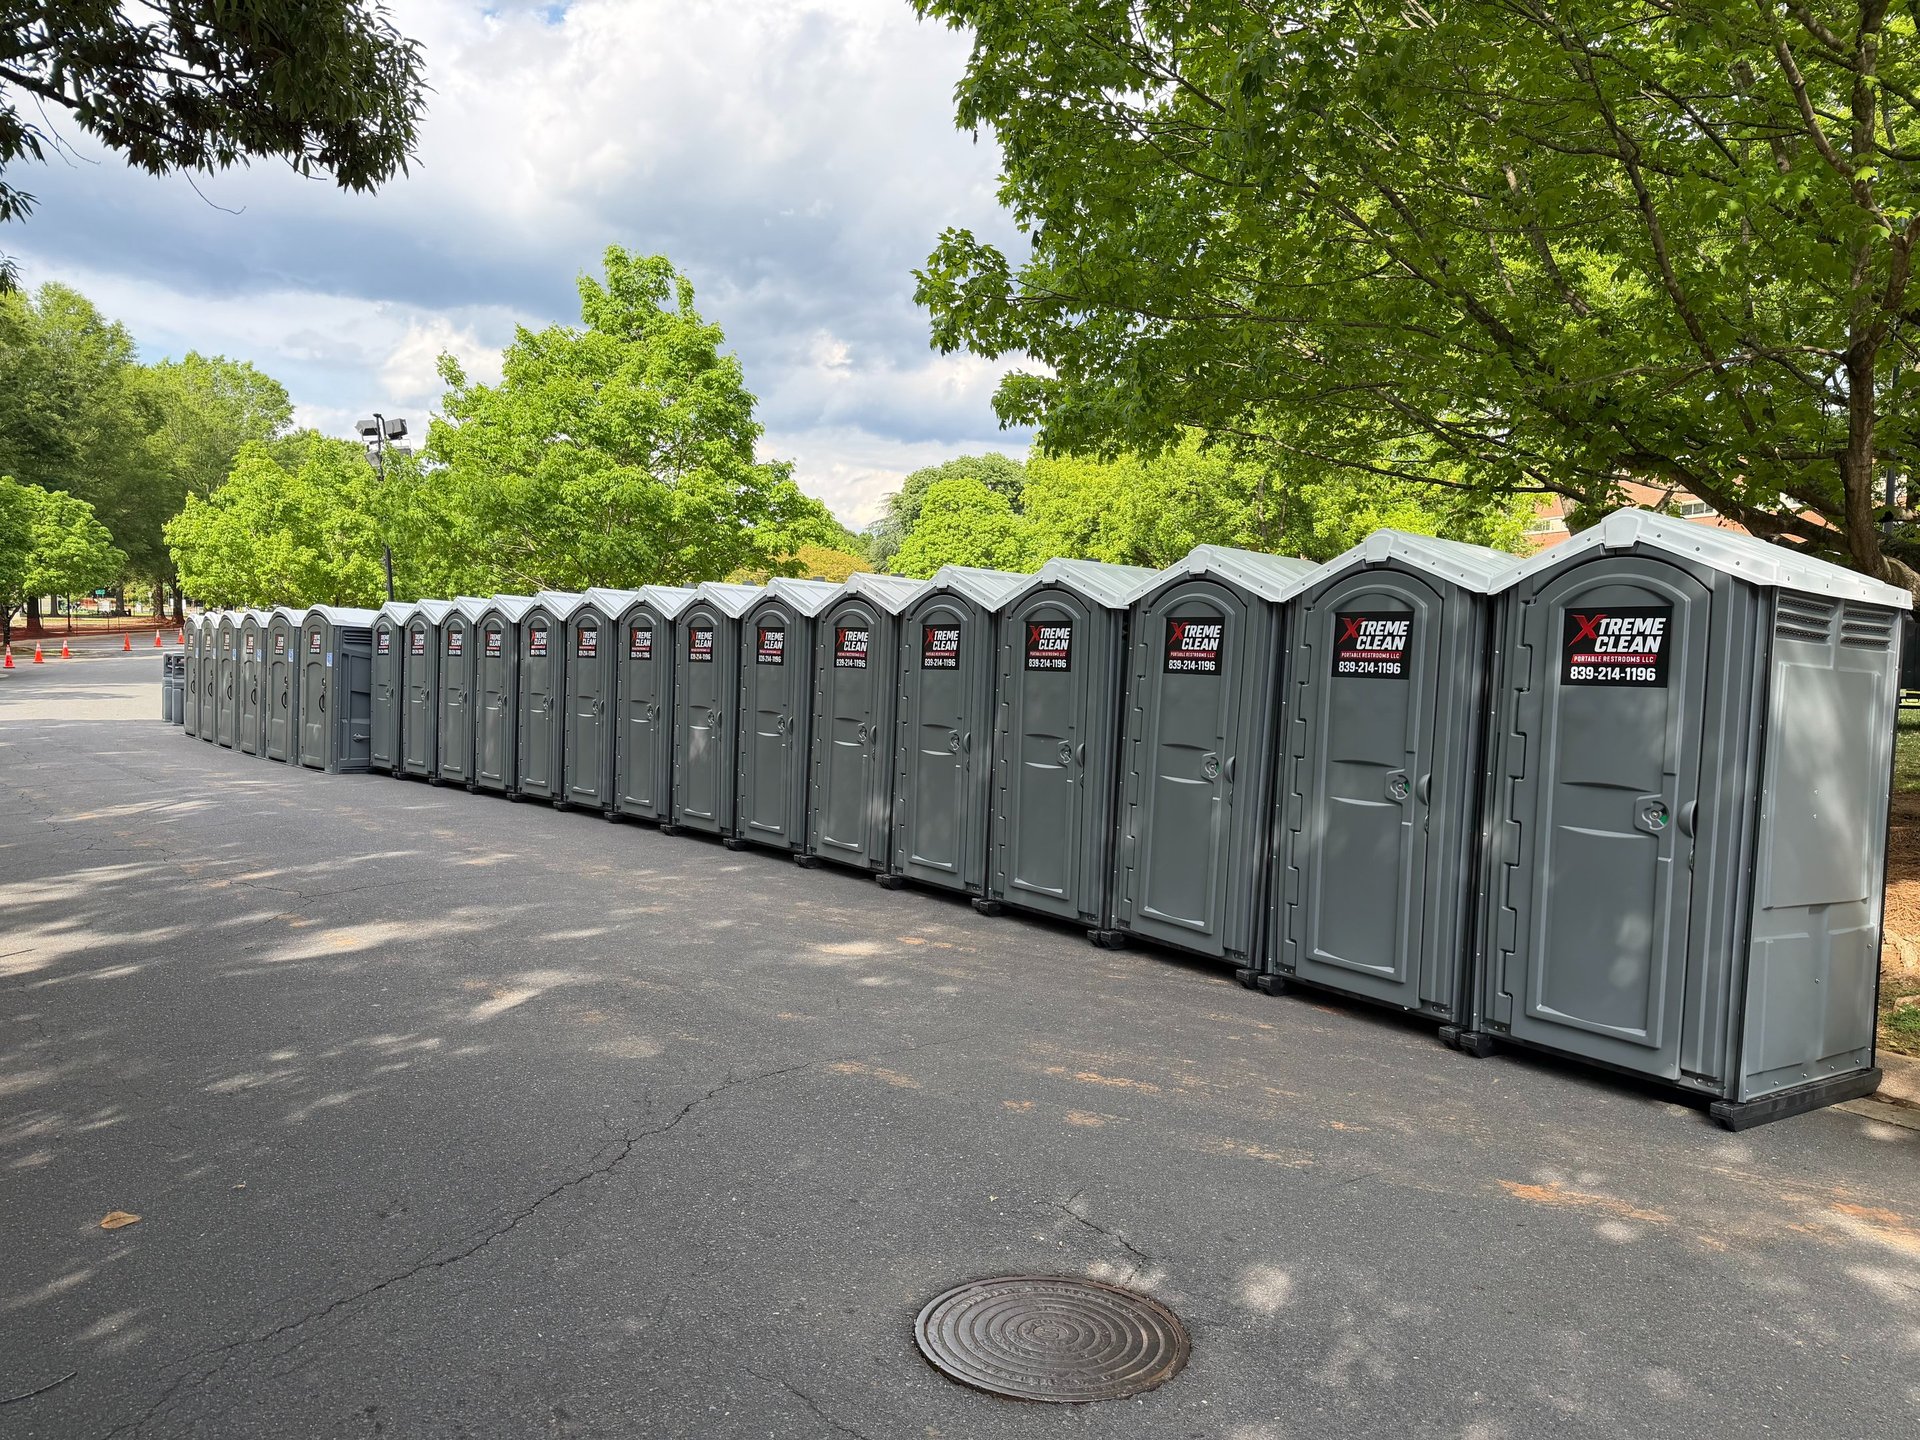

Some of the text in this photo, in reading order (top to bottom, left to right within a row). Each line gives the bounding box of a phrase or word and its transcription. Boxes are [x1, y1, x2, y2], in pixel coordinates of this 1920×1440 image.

[691, 629, 713, 642] XTREME
[759, 629, 784, 644] XTREME
[924, 628, 960, 646] XTREME
[1028, 625, 1071, 645] XTREME
[1168, 621, 1222, 645] XTREME
[1338, 617, 1410, 645] XTREME
[1568, 614, 1666, 647] XTREME
[695, 640, 712, 648] CLEAN
[764, 640, 783, 649] CLEAN
[836, 629, 868, 647] XTREME
[1038, 639, 1069, 650] CLEAN
[1181, 638, 1219, 650] CLEAN
[1356, 636, 1406, 650] CLEAN
[1594, 636, 1662, 653] CLEAN
[843, 641, 868, 652] CLEAN
[932, 640, 958, 650] CLEAN
[924, 658, 956, 667] 839-214-1196
[1028, 658, 1067, 668] 839-214-1196
[1168, 660, 1216, 671] 839-214-1196
[1573, 655, 1602, 663] PORTABLE
[1338, 661, 1401, 674] 839-214-1196
[1570, 666, 1656, 681] 839-214-1196
